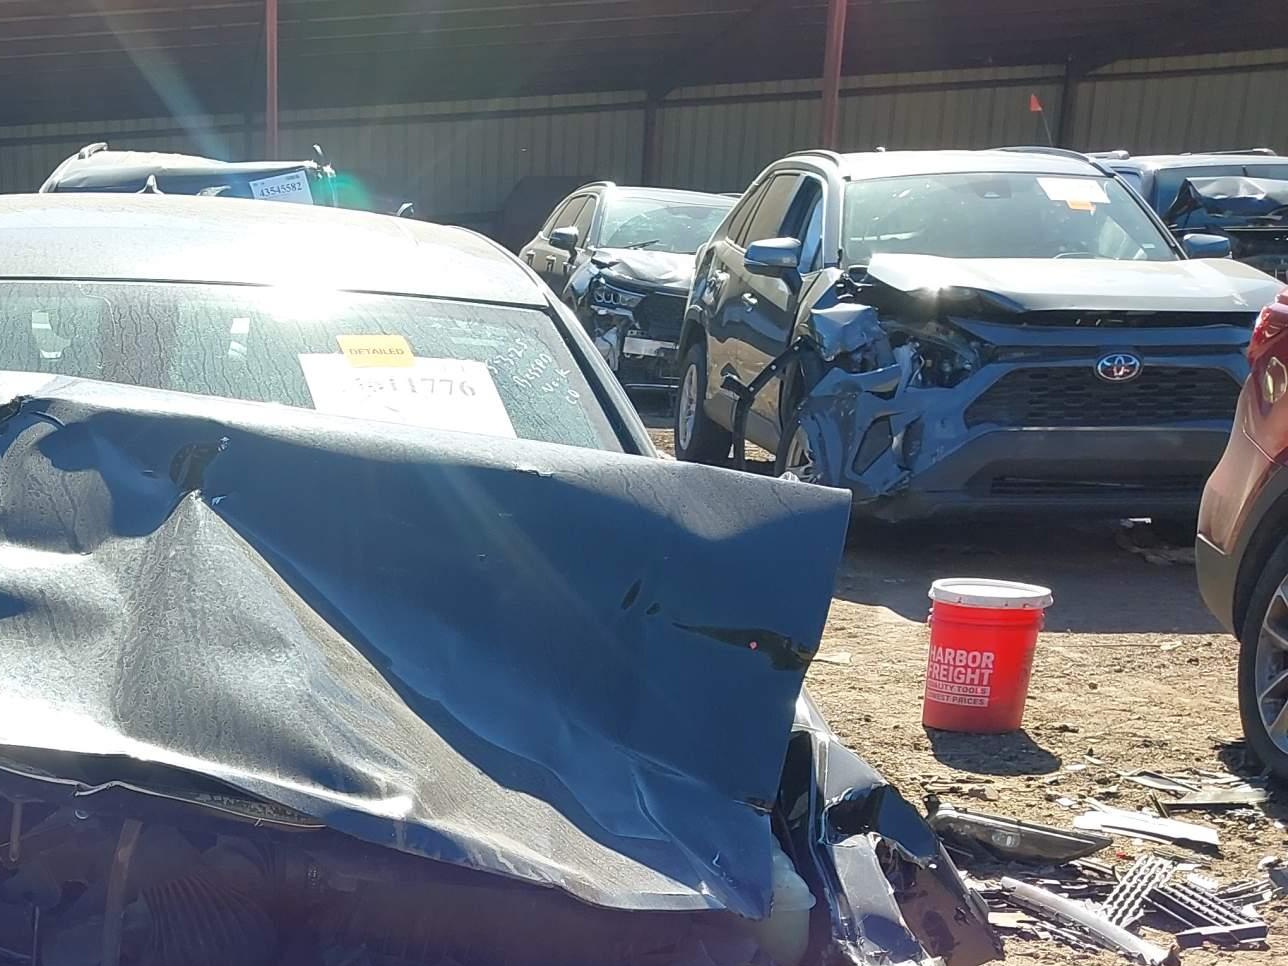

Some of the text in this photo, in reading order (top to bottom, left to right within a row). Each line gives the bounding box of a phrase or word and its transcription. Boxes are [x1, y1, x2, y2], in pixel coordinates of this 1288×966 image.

[260, 183, 303, 197] 43545582
[930, 645, 994, 669] HARBOR
[927, 661, 994, 685] FREIGHT
[956, 685, 988, 695] TOOLS
[952, 696, 986, 706] PRICES
